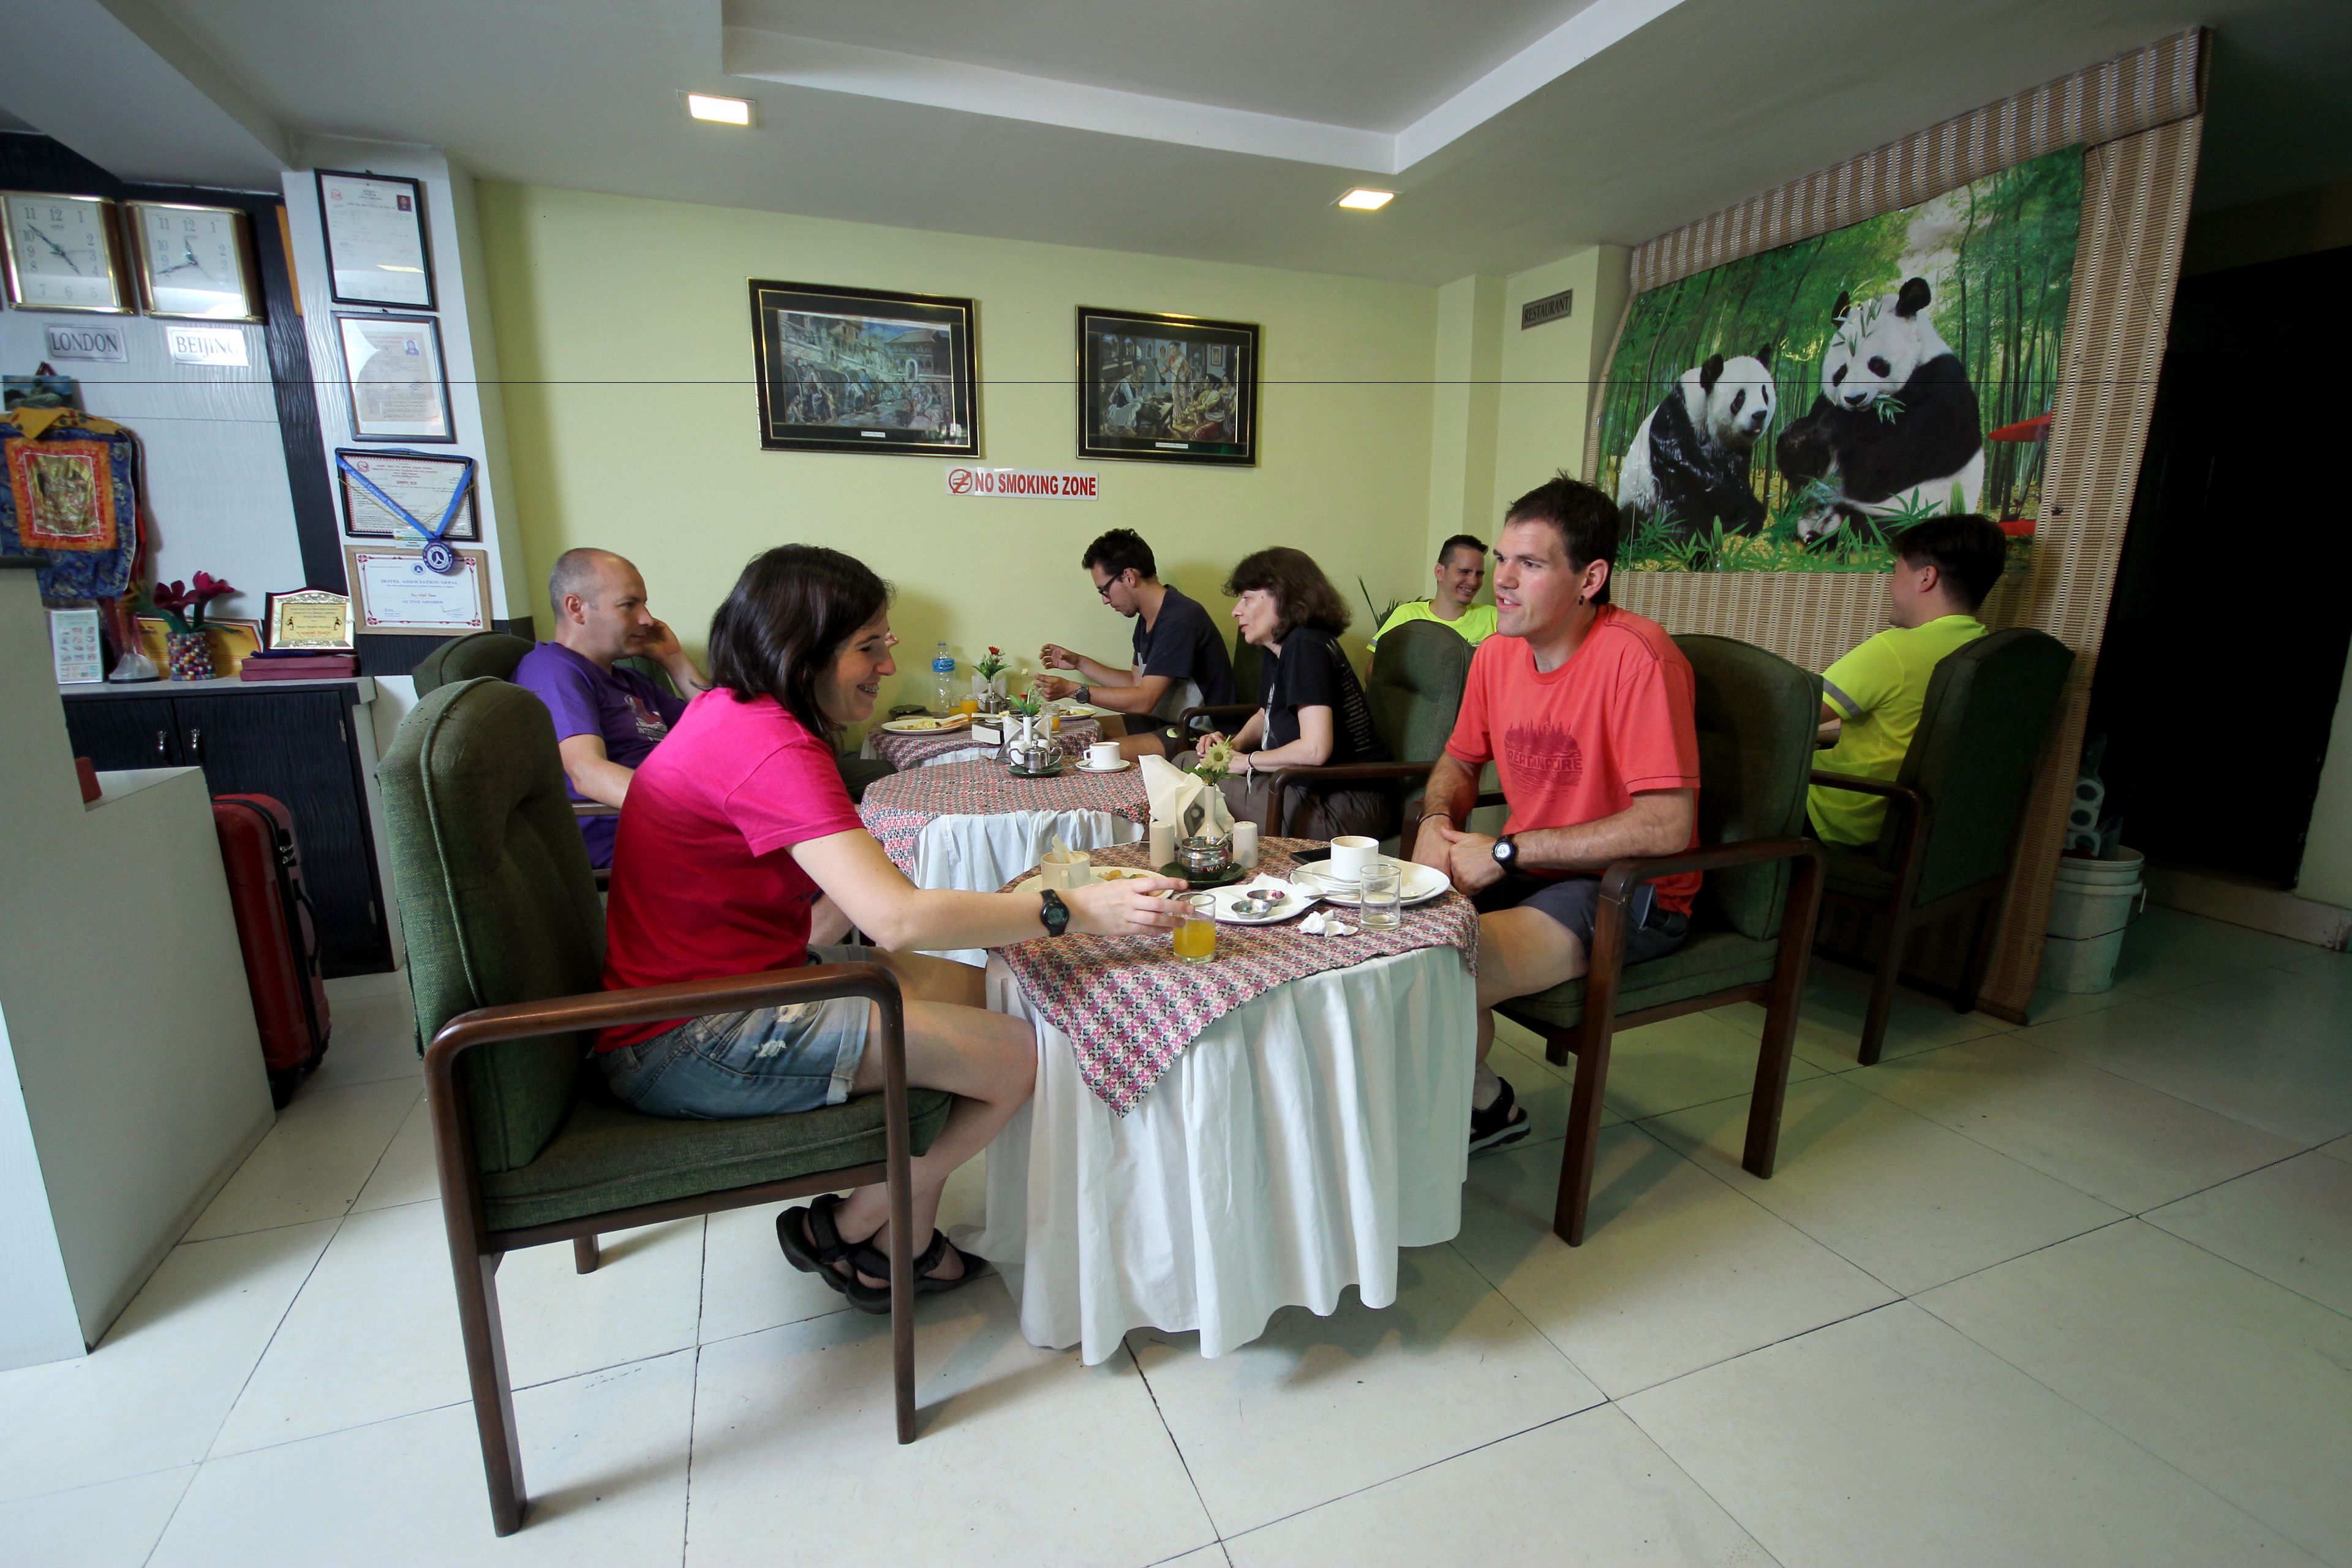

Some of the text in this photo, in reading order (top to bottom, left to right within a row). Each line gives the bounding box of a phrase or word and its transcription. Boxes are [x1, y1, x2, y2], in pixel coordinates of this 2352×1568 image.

[24, 207, 36, 219] 11
[50, 209, 62, 221] 12
[78, 211, 83, 223] 1
[159, 217, 170, 230] 11
[184, 219, 195, 232] 12
[211, 222, 216, 233] 1
[23, 230, 34, 242] 10
[86, 233, 94, 246] 2
[27, 246, 35, 257] 9
[158, 239, 168, 252] 10
[219, 244, 226, 256] 2
[64, 285, 73, 297] 6
[1525, 296, 1569, 323] RESTAURANT
[51, 333, 118, 352] LONDON
[975, 472, 1096, 496] NO SMOKING ZONE
